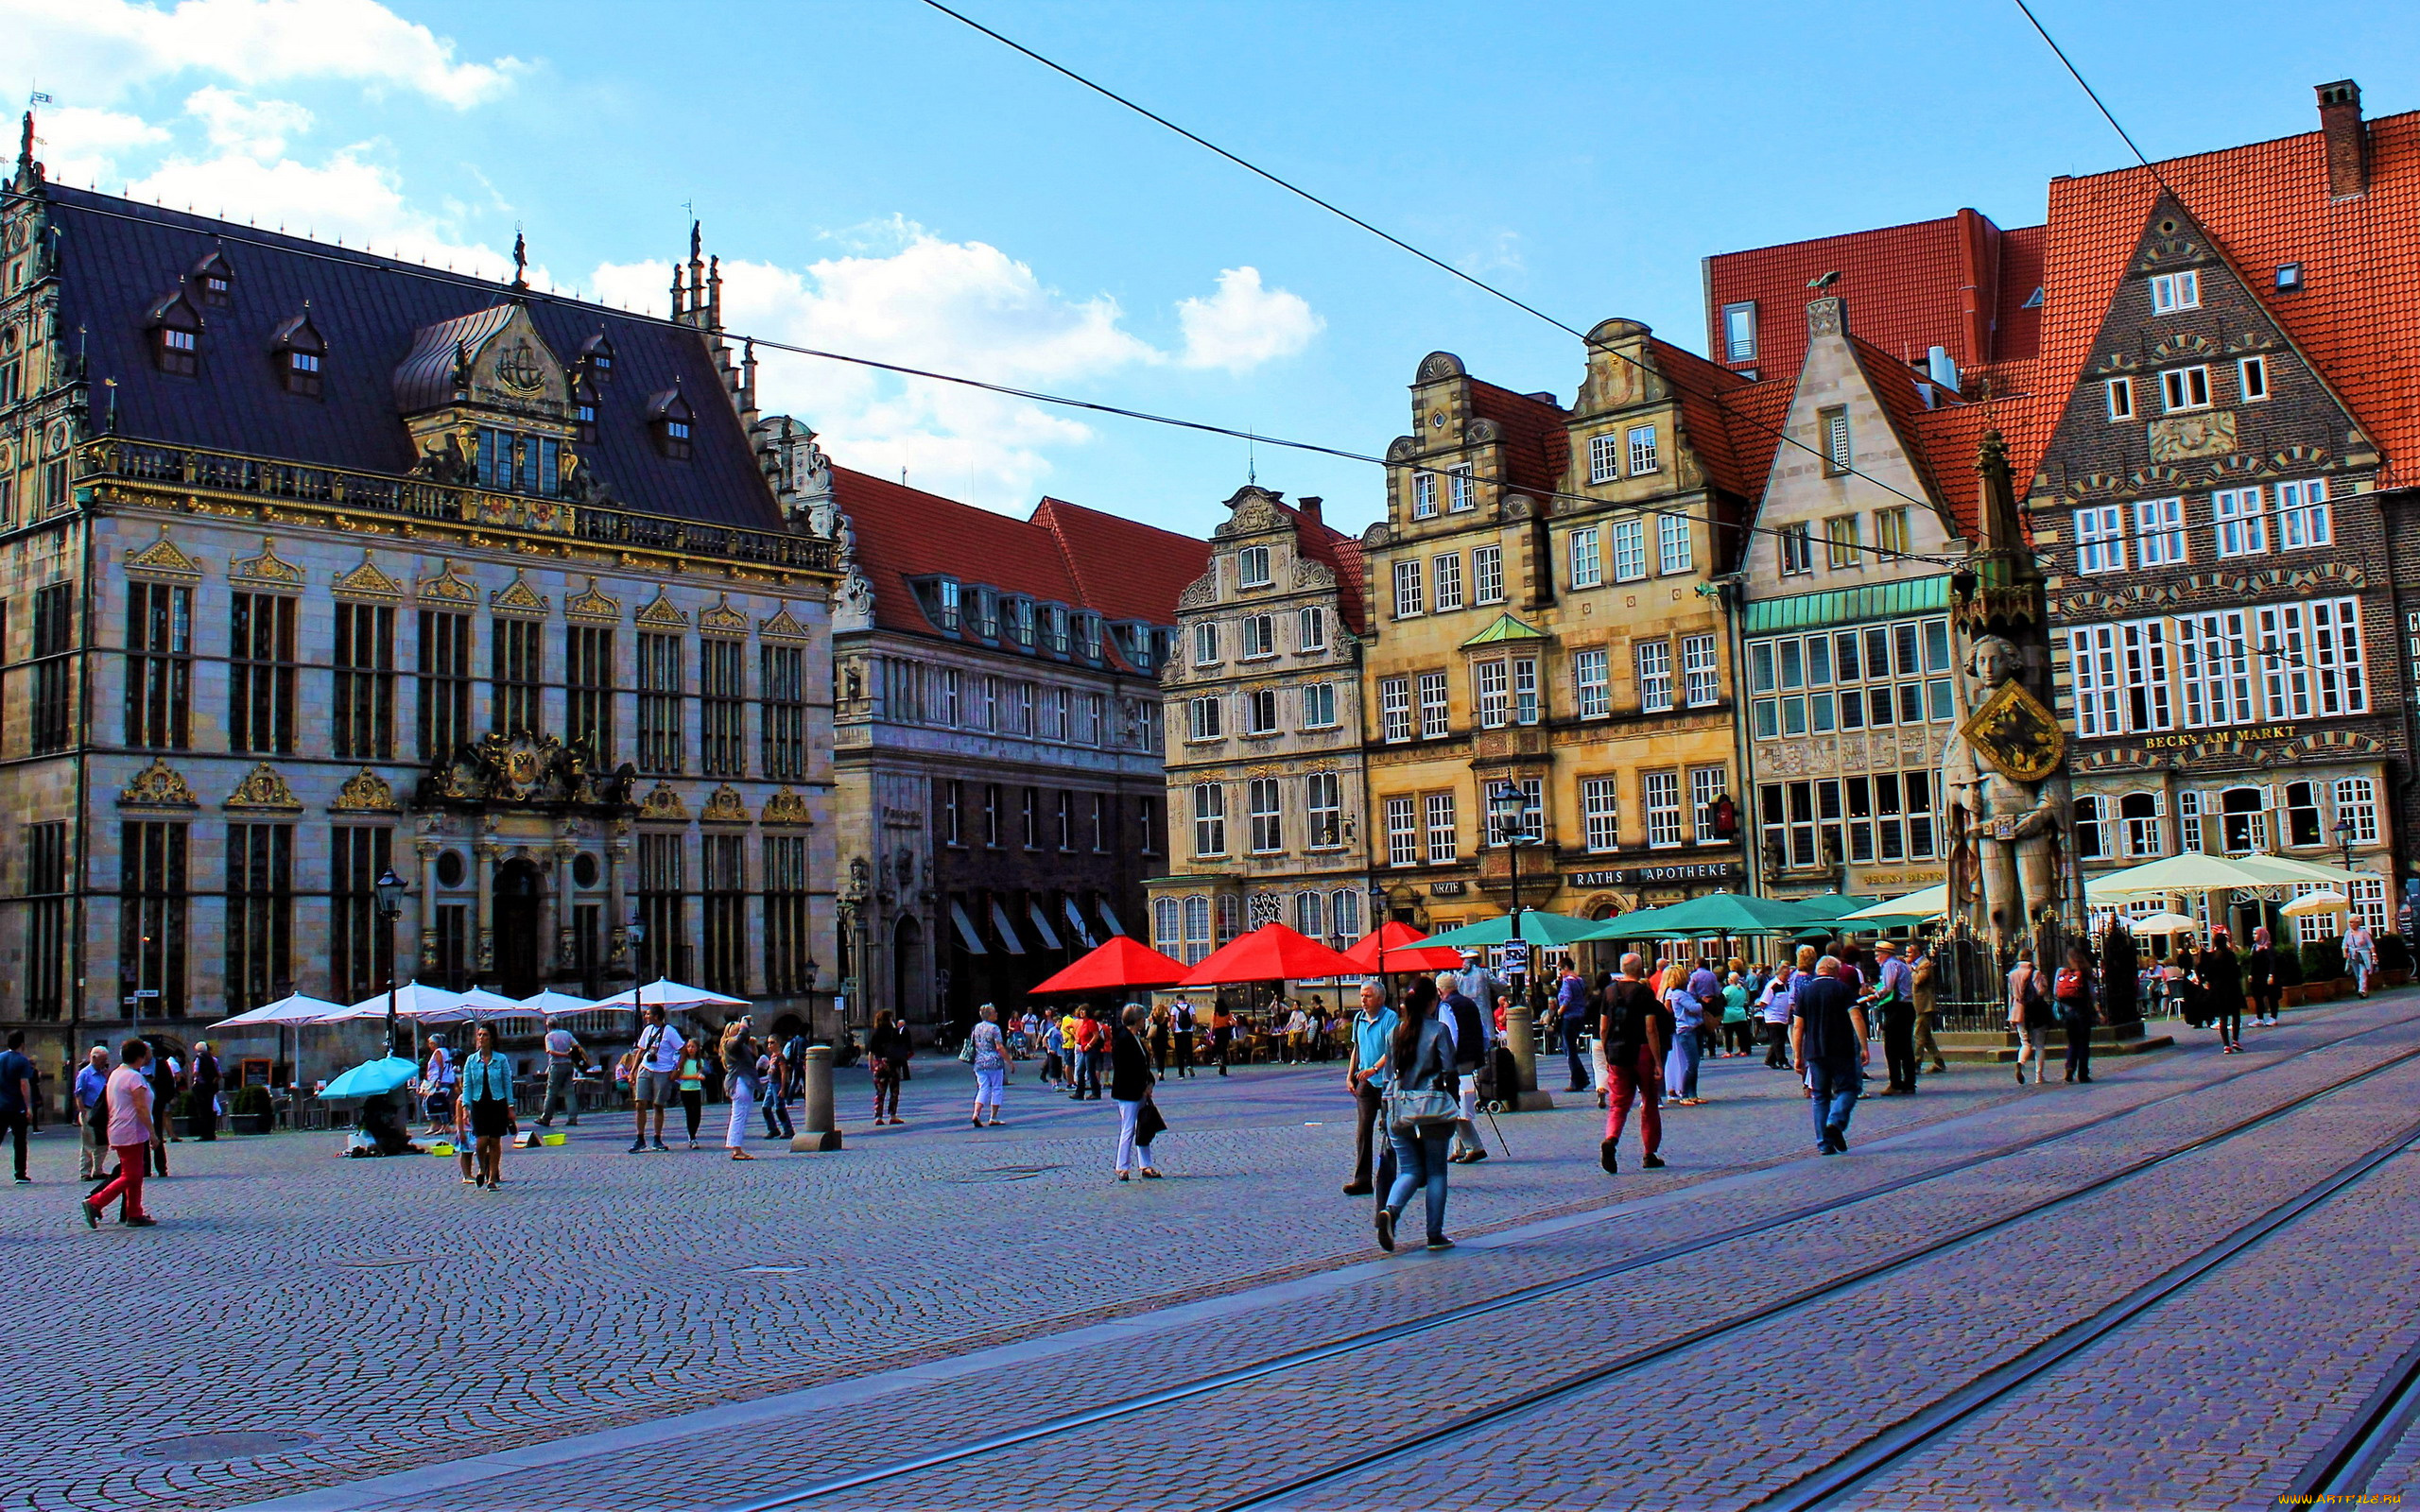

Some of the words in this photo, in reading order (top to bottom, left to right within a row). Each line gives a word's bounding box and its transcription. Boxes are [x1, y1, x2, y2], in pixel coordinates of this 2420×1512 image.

[2146, 733, 2198, 748] BECK's
[2204, 731, 2229, 744] AM
[2236, 726, 2296, 741] MARKT
[1577, 871, 1623, 885] RATHS
[1646, 864, 1727, 880] APOTHEKE
